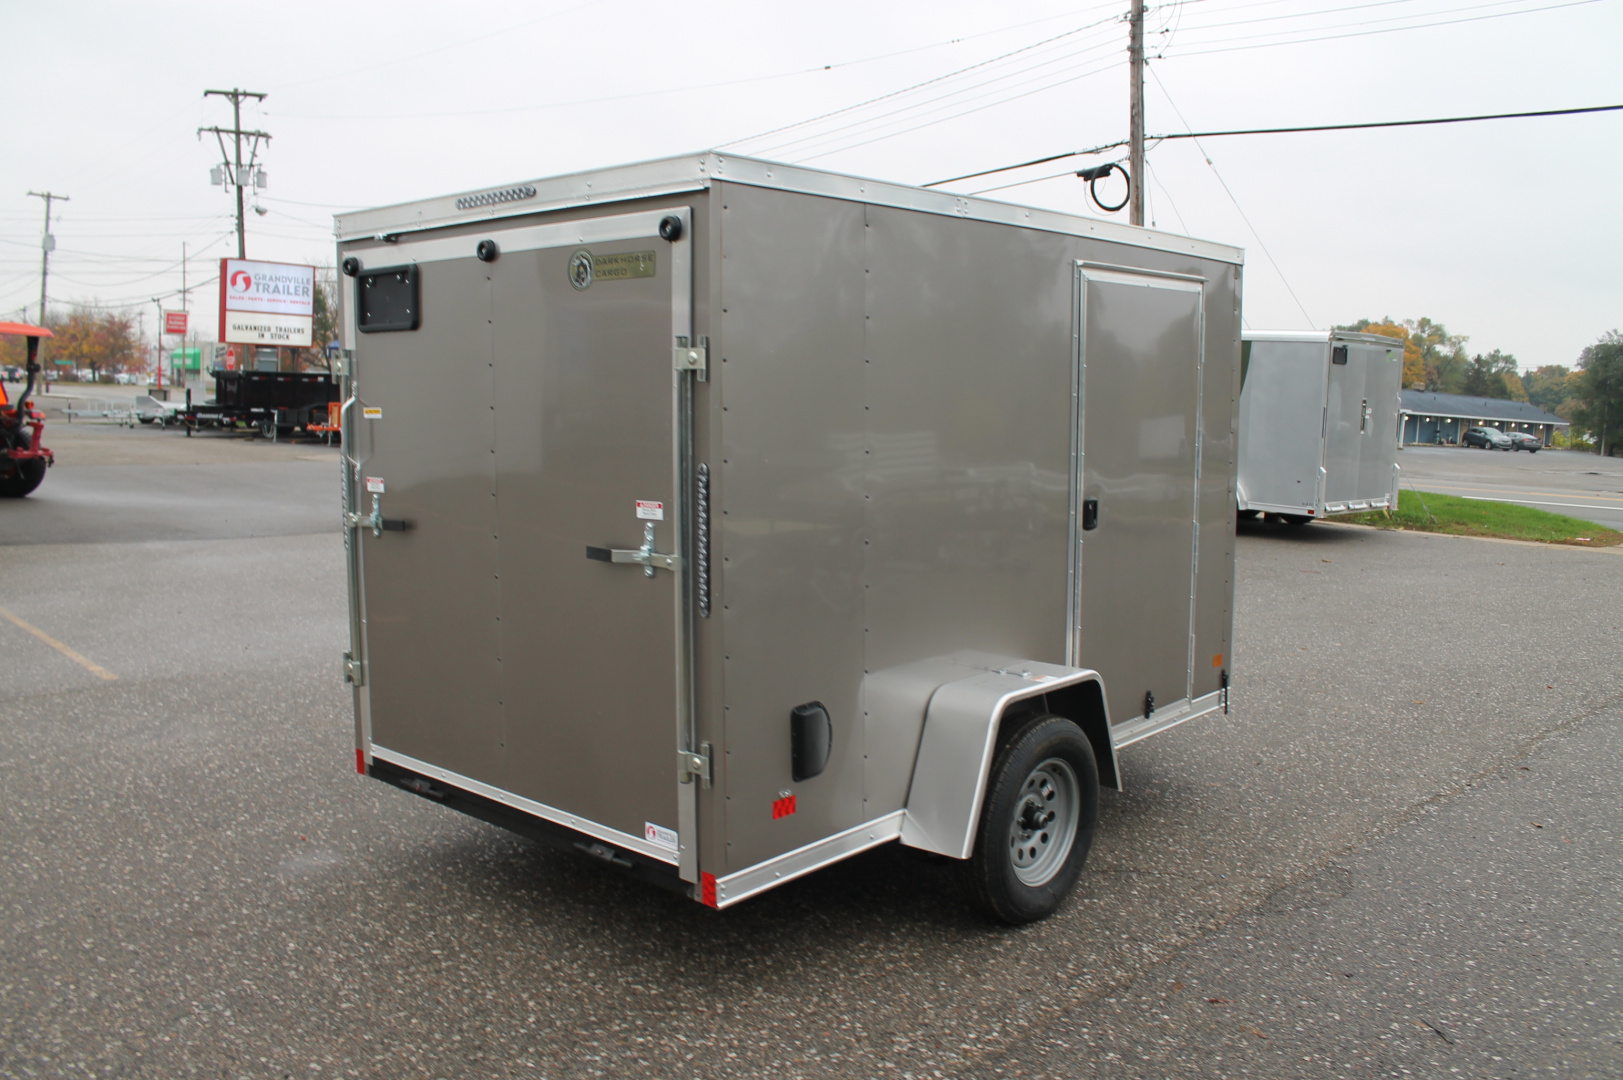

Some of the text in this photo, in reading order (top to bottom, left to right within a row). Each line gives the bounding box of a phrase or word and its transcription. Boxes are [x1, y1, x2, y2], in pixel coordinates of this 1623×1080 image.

[595, 254, 654, 265] DARKHORSE
[595, 268, 627, 277] CARGO
[253, 273, 311, 285] GRANDVILLE
[253, 282, 310, 297] TRAILER
[232, 324, 305, 334] GALVANIZED TRAILERS
